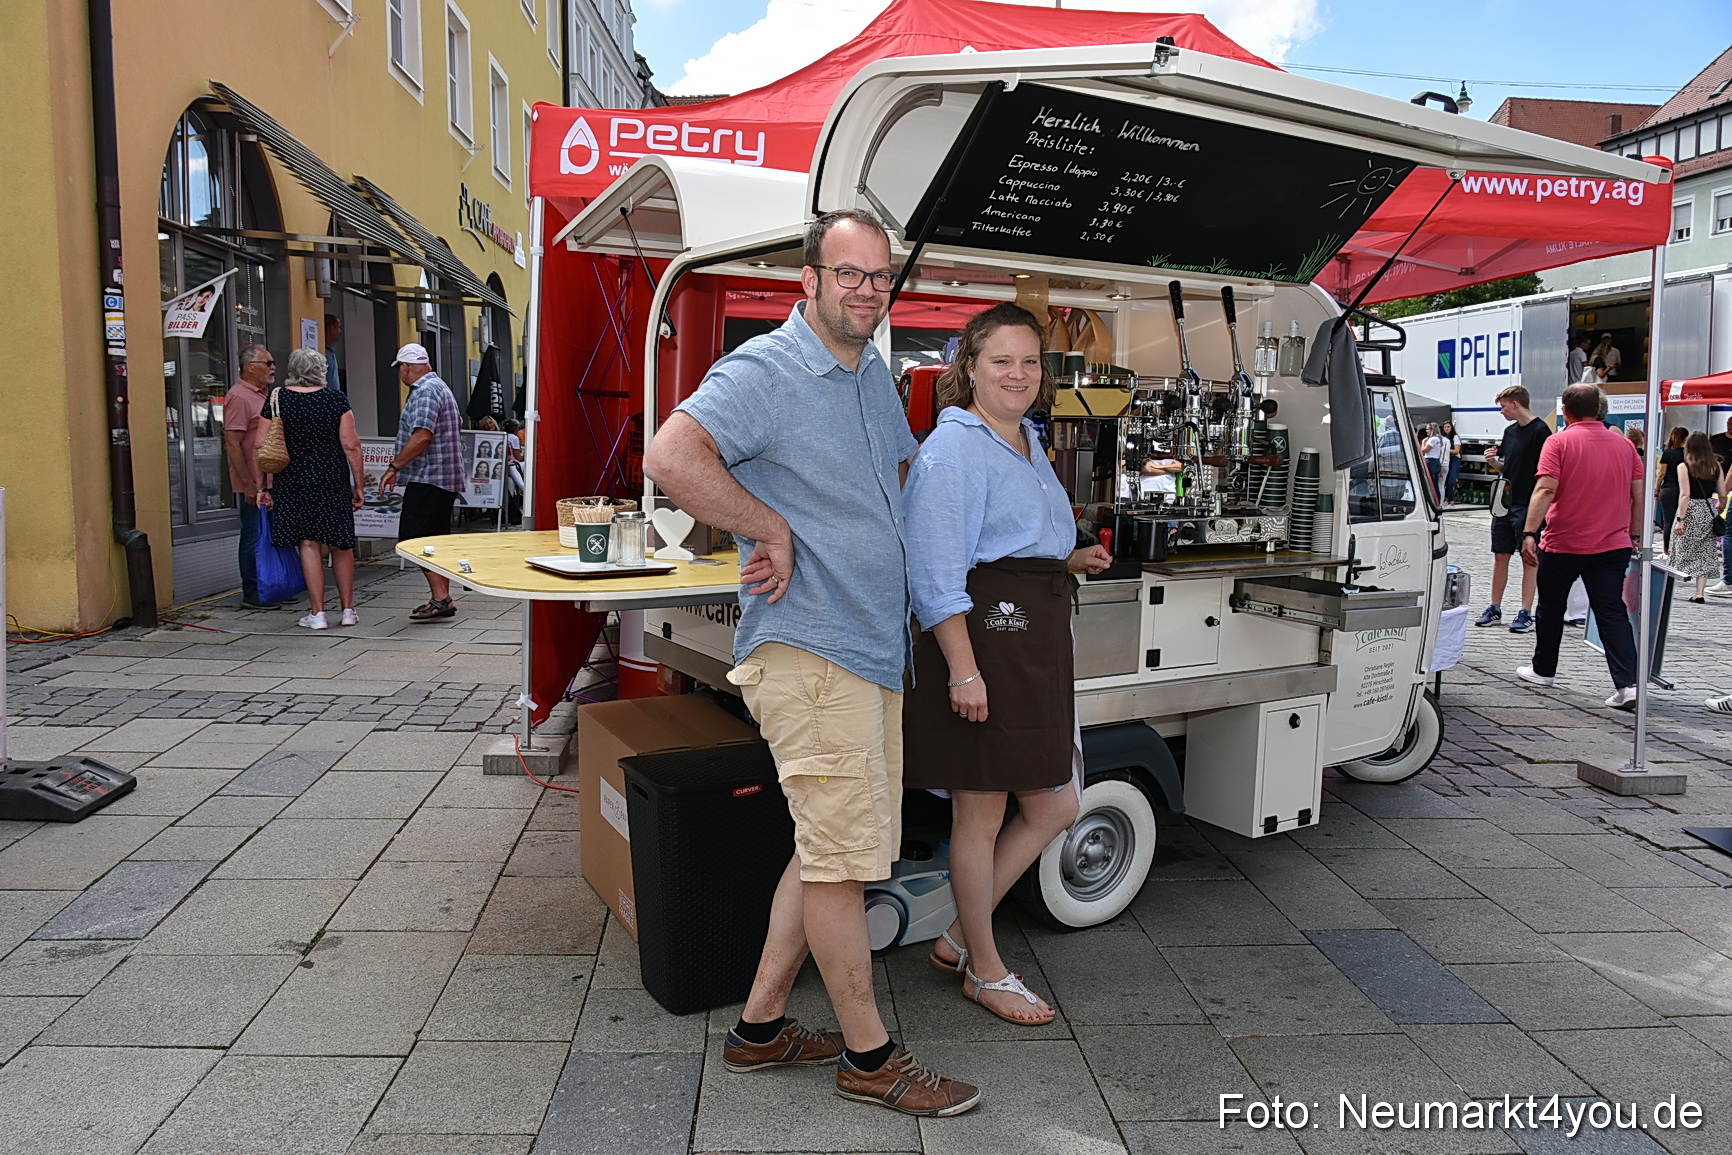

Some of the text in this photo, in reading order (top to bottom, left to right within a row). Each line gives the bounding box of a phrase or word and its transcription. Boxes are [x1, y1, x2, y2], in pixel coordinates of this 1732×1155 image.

[1032, 105, 1200, 152] Herzlich Willkommen
[609, 117, 766, 167] Petry
[1025, 130, 1096, 156] Preisliste:
[608, 164, 630, 177] WÄ
[1008, 154, 1059, 174] Espresso
[998, 174, 1061, 192] Cappuccino
[1461, 176, 1646, 206] www.petry.ag
[988, 189, 1020, 204] Latte
[980, 204, 1042, 222] Americano
[971, 221, 1033, 238] Filterkaffee
[167, 320, 199, 330] BILDER
[175, 312, 198, 321] PASS
[361, 446, 395, 456] BERSPIEL
[1369, 645, 1381, 654] SEIT
[735, 785, 759, 795] CURVER
